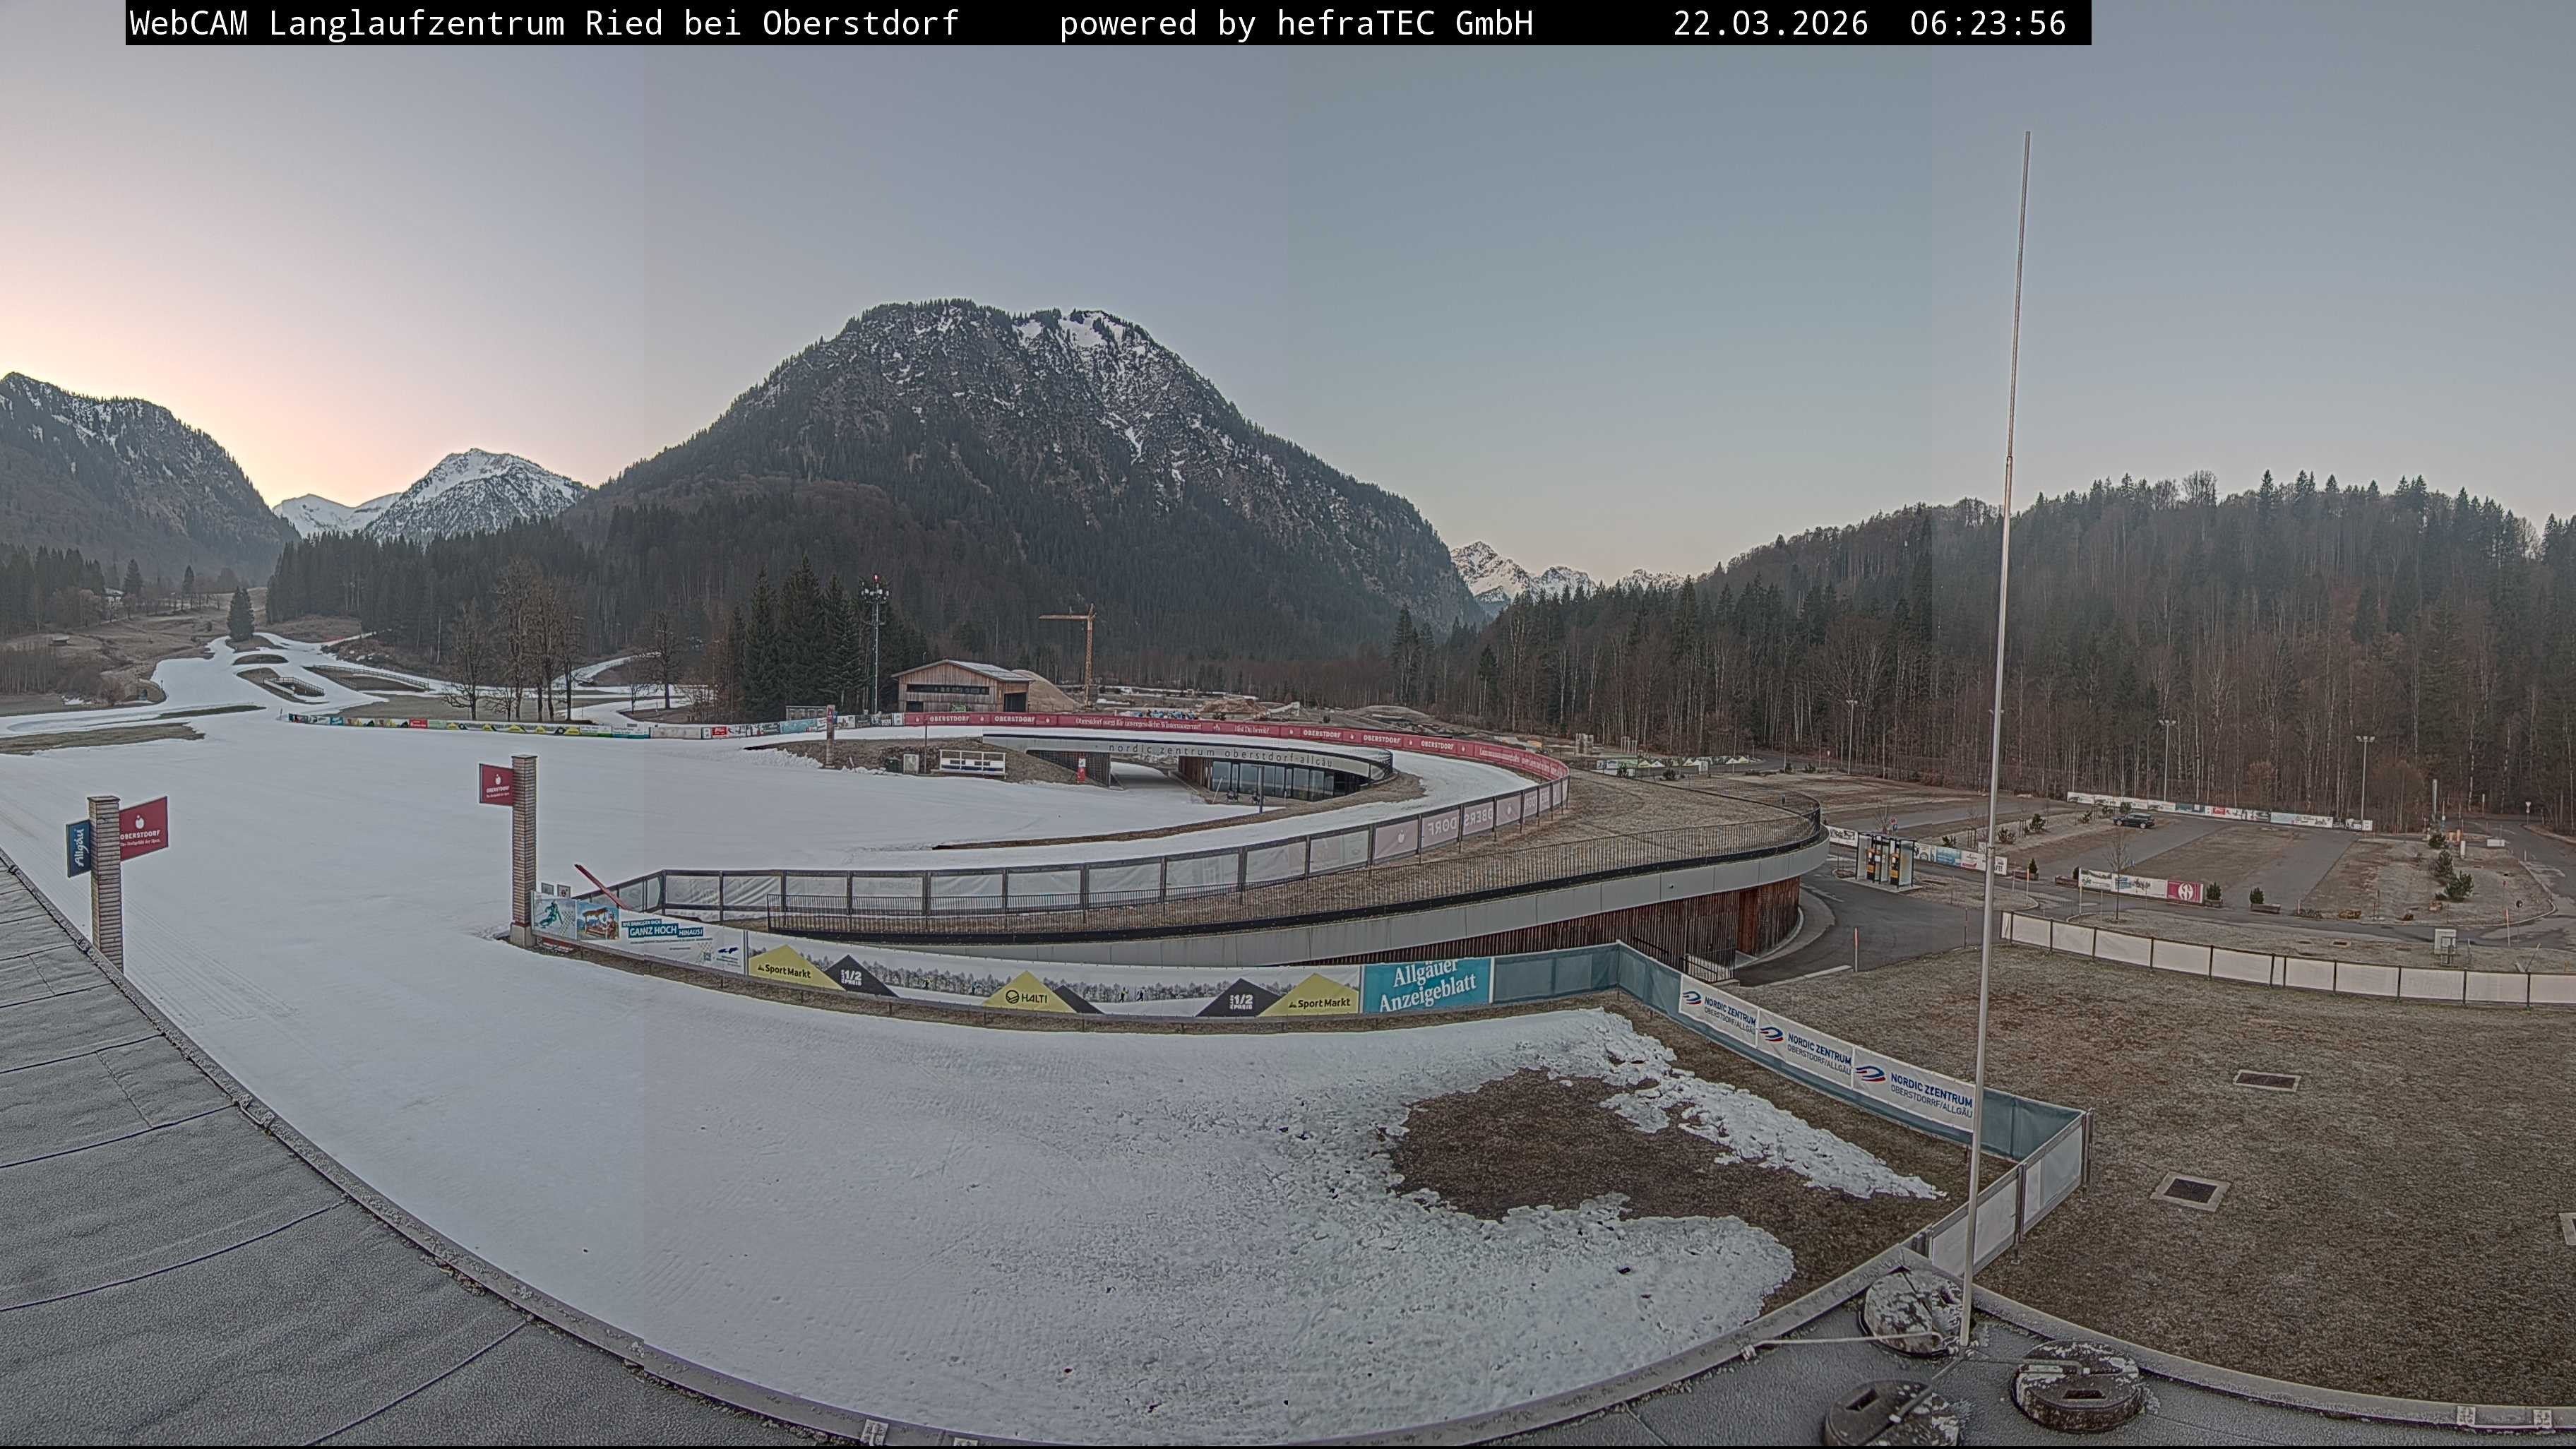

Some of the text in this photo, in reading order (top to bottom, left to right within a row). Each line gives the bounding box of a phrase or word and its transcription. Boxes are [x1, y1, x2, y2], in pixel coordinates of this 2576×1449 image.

[1303, 729, 1341, 739] OBERSTDORF
[1363, 734, 1402, 744] OBERSTDORF
[1109, 743, 1152, 753] nordic
[1159, 746, 1215, 757] zentrum
[1421, 739, 1455, 751] OBERSTDORF
[119, 830, 161, 840] OBERSTDORF
[654, 925, 677, 934] HOCH
[845, 970, 861, 980] 1/2
[1393, 960, 1458, 987] Allgäuer
[1021, 993, 1047, 1003] HALTI
[1234, 994, 1253, 1004] 1/2
[1379, 973, 1477, 1013] Anzeigeblatt
[1704, 996, 1757, 1025] NORDIC ZENTRUM
[1788, 1032, 1852, 1066] NORDIC ZENTRUM
[1787, 1044, 1852, 1075] OBERSTDORF/ALLGÄU
[1890, 1072, 1924, 1092] NORDIC
